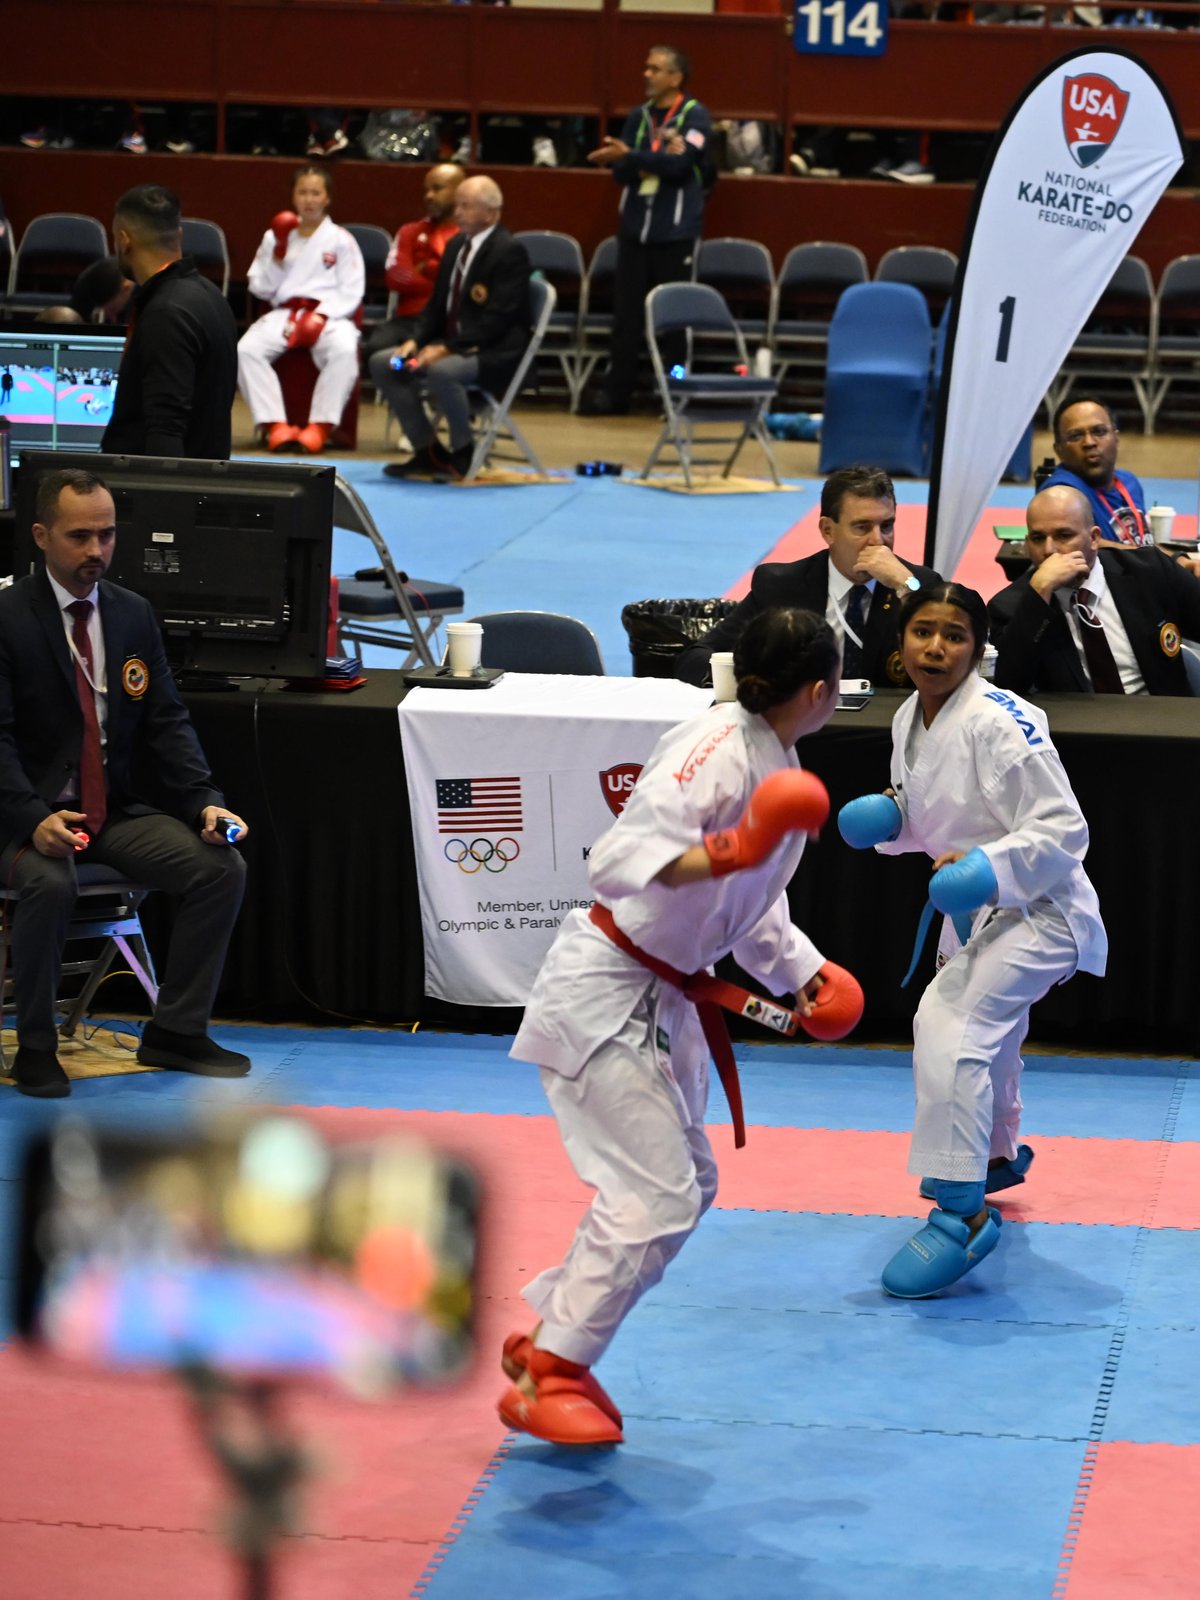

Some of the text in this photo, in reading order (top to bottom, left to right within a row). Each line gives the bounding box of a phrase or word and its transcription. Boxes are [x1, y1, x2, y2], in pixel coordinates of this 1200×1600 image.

[798, 0, 883, 47] 114
[1069, 84, 1117, 120] USA
[1045, 171, 1113, 197] NATIONAL
[1017, 181, 1133, 223] KARATE-DO
[1038, 209, 1107, 233] FEDERATION
[995, 296, 1016, 363] 1
[982, 692, 1044, 746] SMAI
[608, 774, 636, 792] US
[477, 900, 544, 913] Member,
[438, 917, 499, 934] Olympic
[504, 918, 516, 929] &
